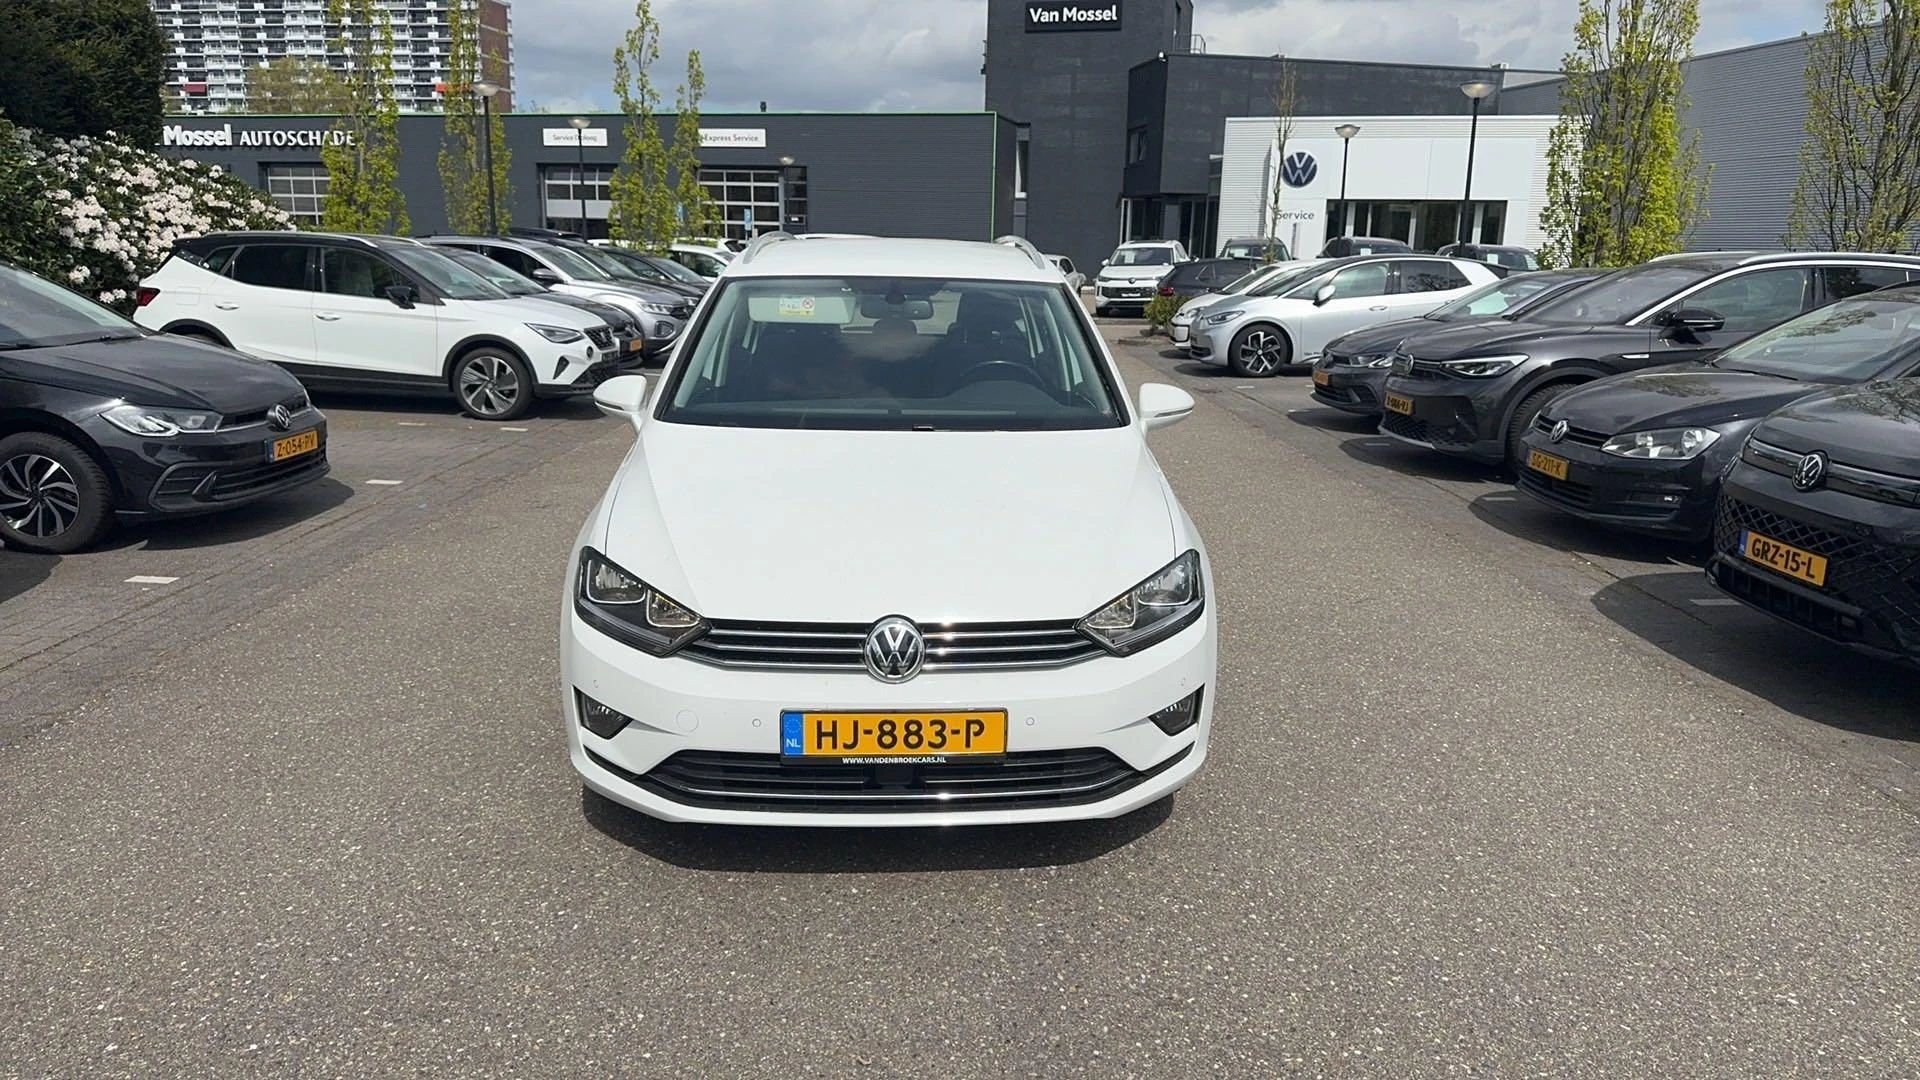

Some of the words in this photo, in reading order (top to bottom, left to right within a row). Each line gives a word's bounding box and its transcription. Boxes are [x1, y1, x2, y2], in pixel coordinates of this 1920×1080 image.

[1029, 8, 1060, 22] Van
[1062, 4, 1118, 22] Mossel
[163, 123, 233, 146] Mossel
[733, 133, 759, 142] Service
[1751, 537, 1816, 579] GRZ-15-L
[785, 738, 801, 748] NL
[815, 718, 986, 751] HJ-883-P
[841, 756, 947, 764] WWW.VANDENBROEKCARS.NL
